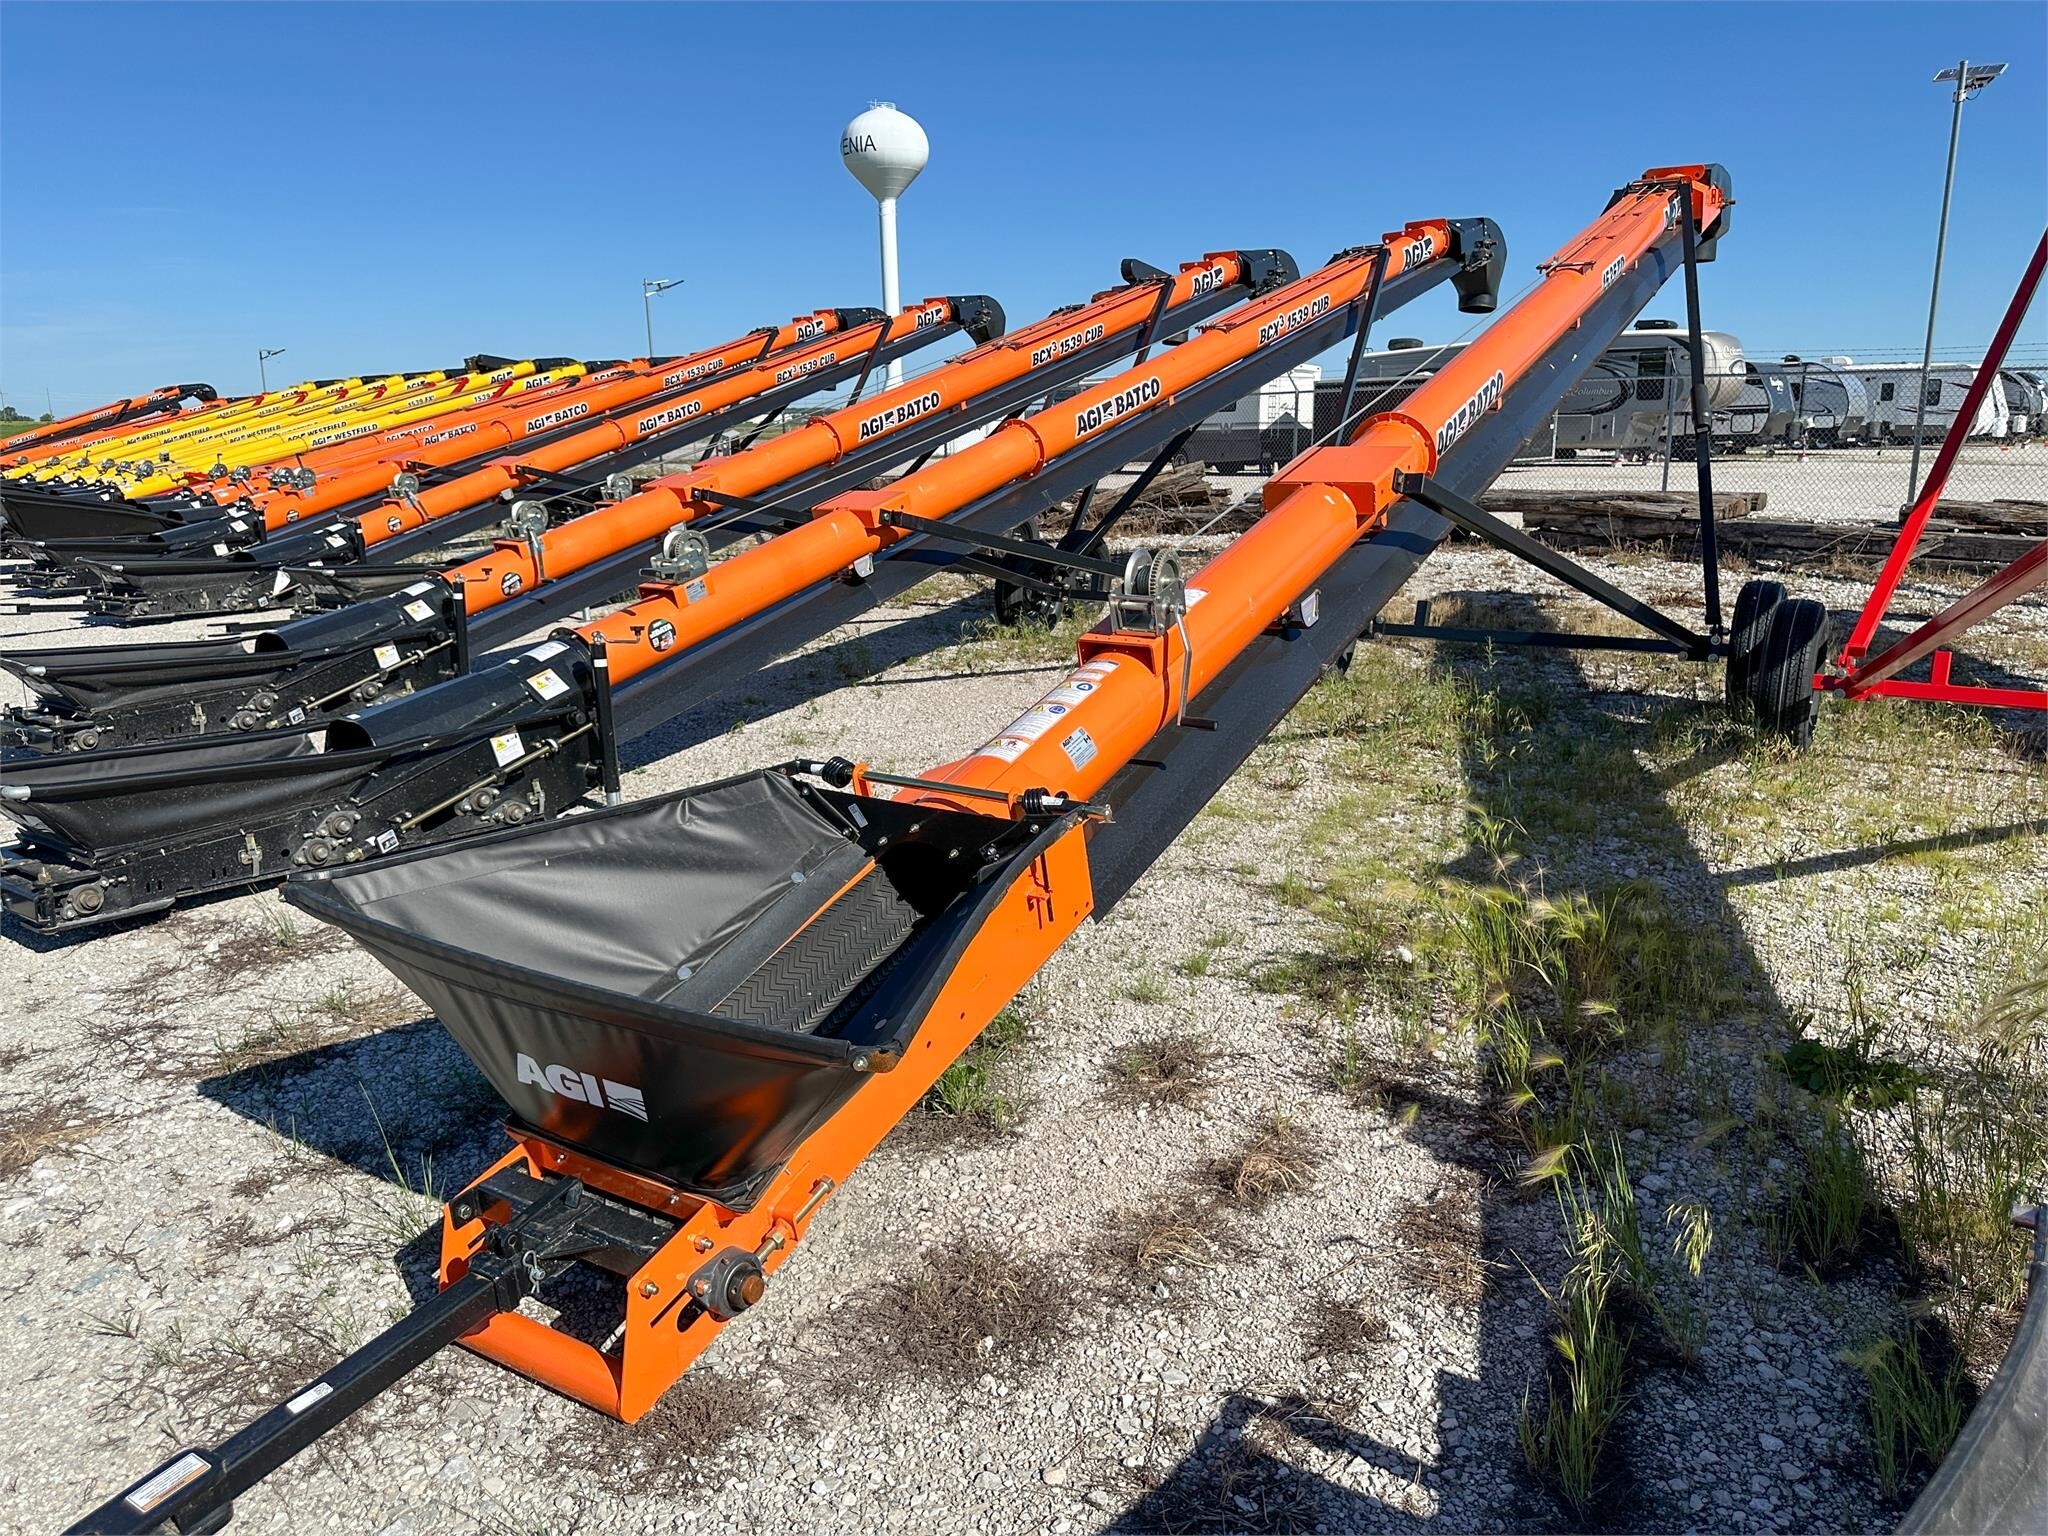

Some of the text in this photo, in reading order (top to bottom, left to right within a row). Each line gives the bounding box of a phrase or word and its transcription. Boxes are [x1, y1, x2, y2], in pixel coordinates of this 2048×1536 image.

[1402, 243, 1424, 271] AGI
[1191, 270, 1213, 297] AGI
[917, 311, 934, 330] AGI
[1286, 304, 1310, 330] 1539
[1310, 295, 1330, 317] CUB
[797, 322, 815, 341] AGI
[1059, 335, 1083, 355] 1539
[1084, 324, 1104, 344] CUB
[686, 365, 706, 379] 1539
[707, 359, 724, 372] CUB
[799, 359, 818, 375] 1539
[819, 352, 836, 367] CUB
[490, 373, 507, 384] AGI
[525, 378, 542, 391] AGI
[474, 392, 491, 403] 1539
[1075, 378, 1161, 438] AGI BATCO
[527, 403, 588, 433] AGI BATCO
[639, 401, 701, 433] AGI BATCO
[859, 392, 940, 440] AGI BATCO
[1436, 372, 1504, 456] AGI BATCO
[307, 421, 347, 437] WESTFIELD
[312, 436, 327, 447] AGI
[334, 423, 378, 441] WESTFIELD
[424, 423, 477, 446] AGI BATCO
[516, 1052, 605, 1108] AGI
